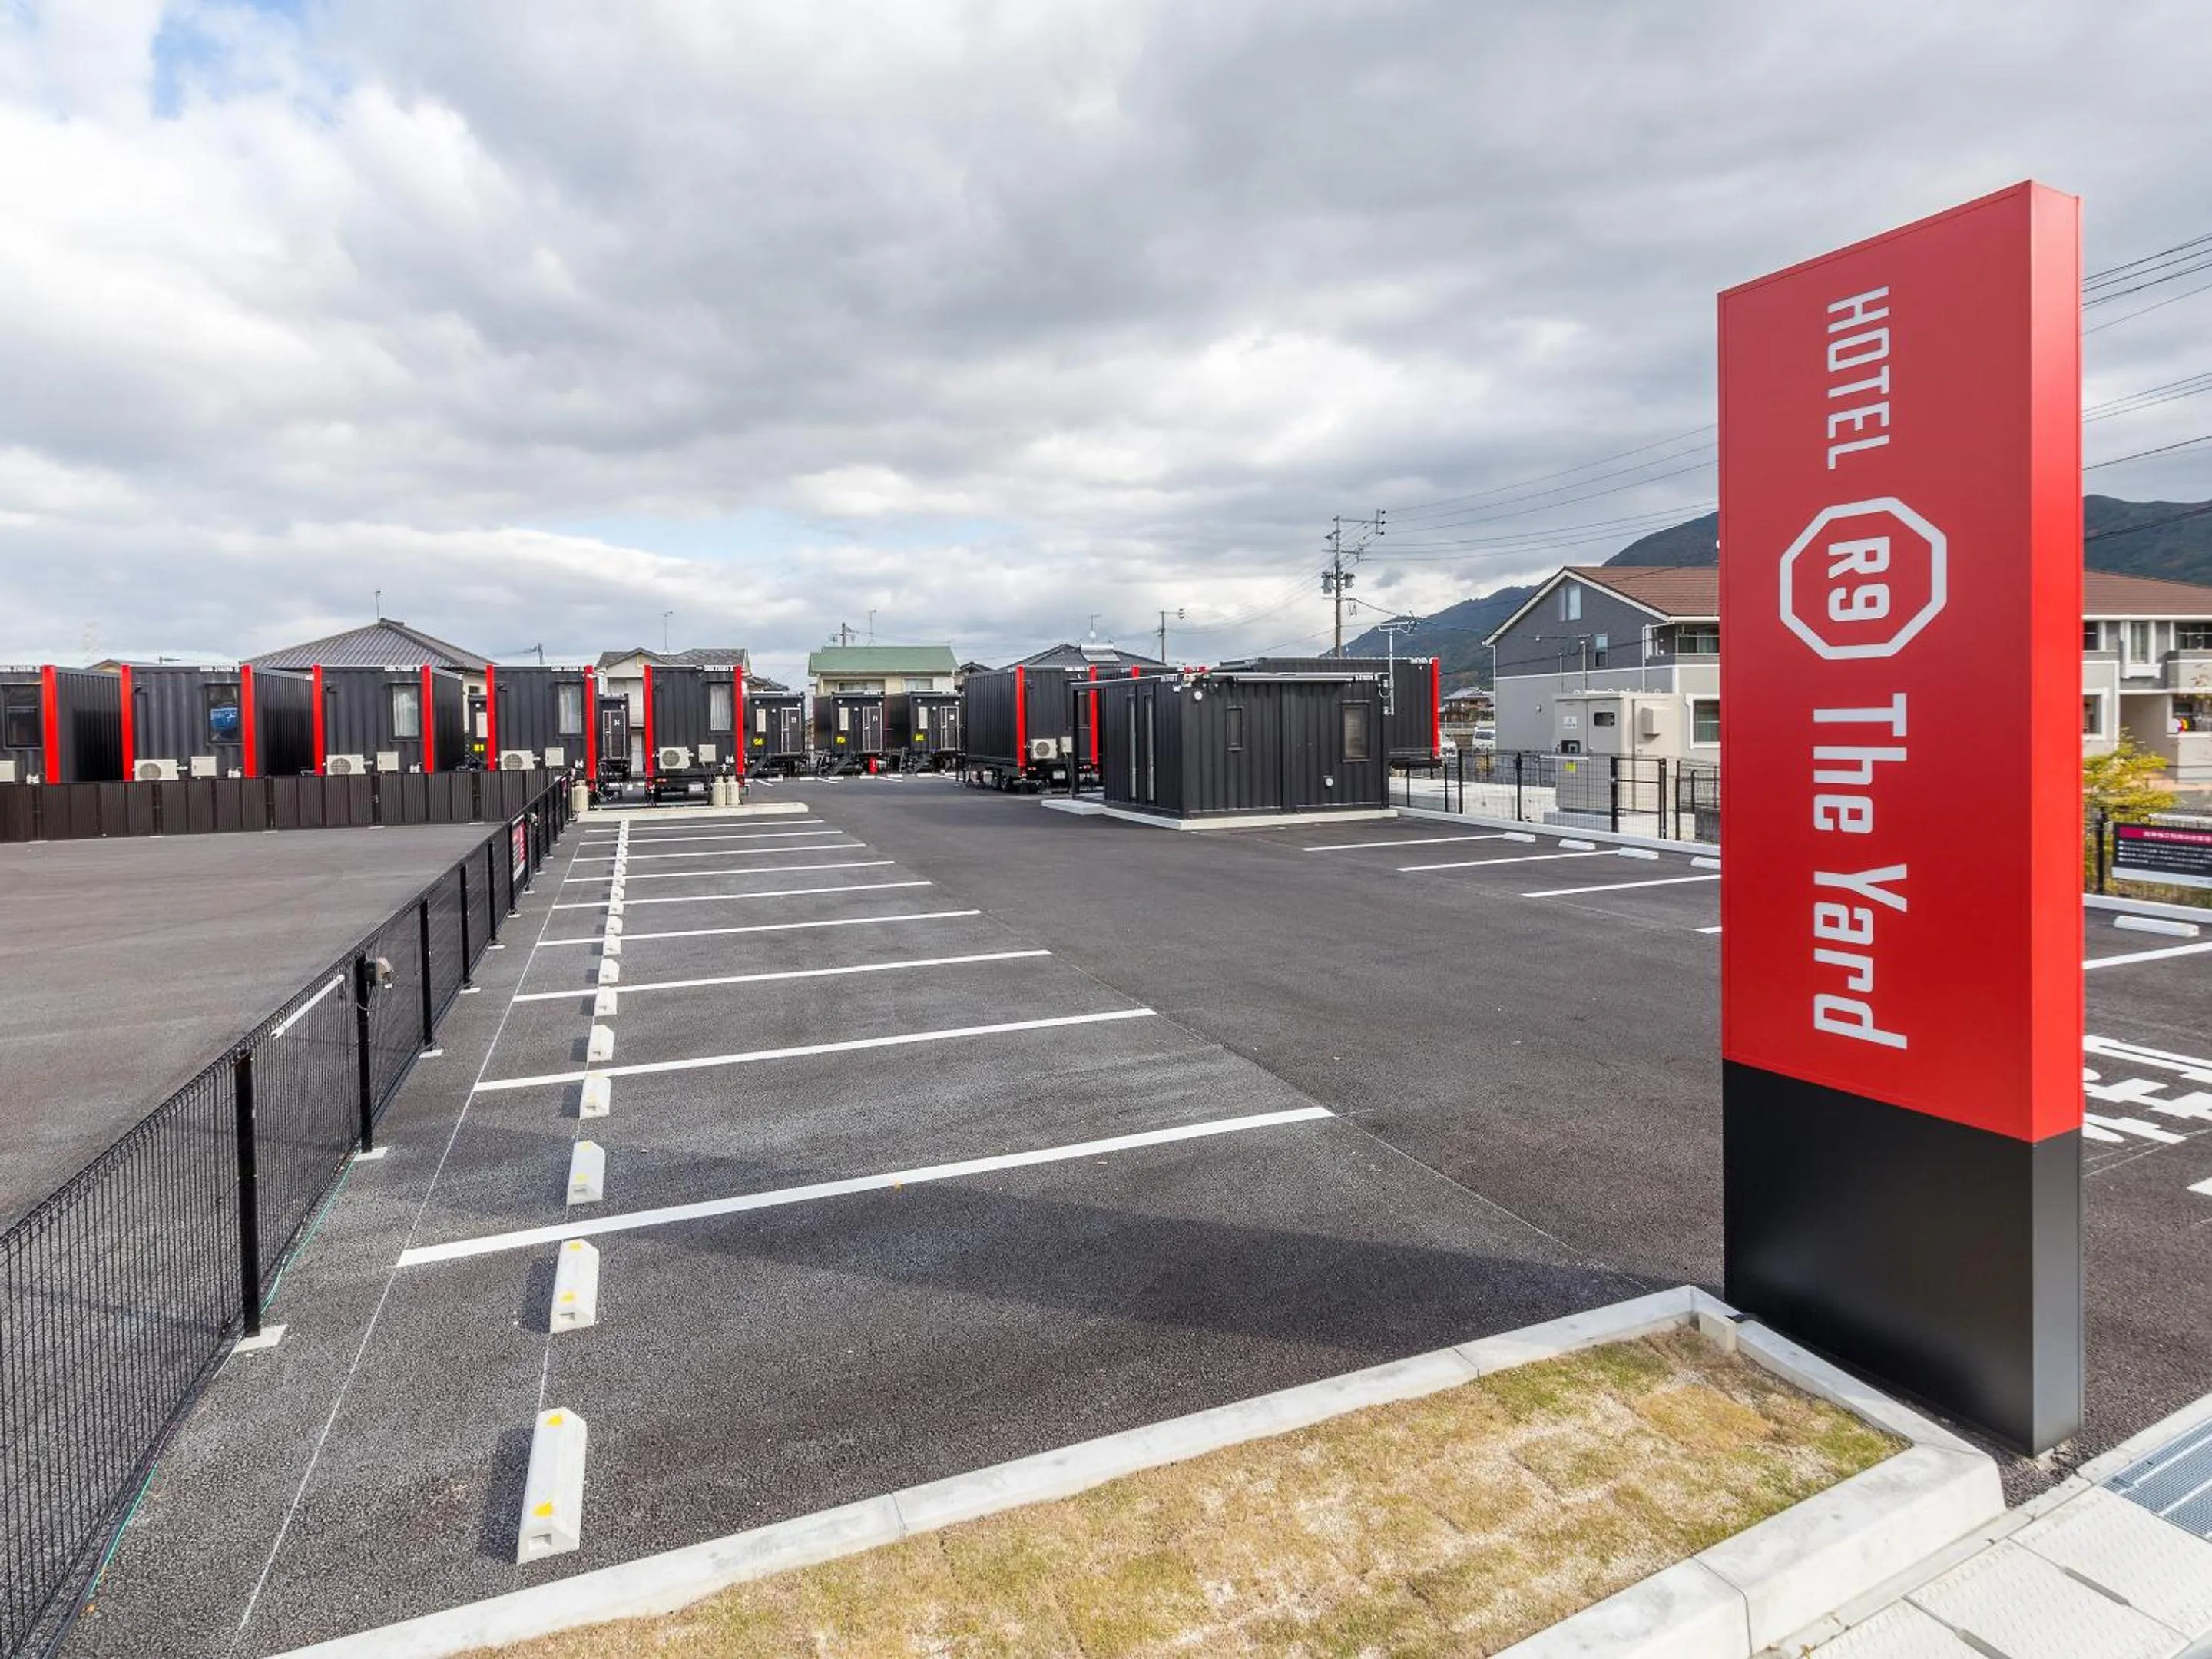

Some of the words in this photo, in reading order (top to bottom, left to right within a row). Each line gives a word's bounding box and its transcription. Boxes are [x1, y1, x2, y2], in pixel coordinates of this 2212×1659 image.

[1828, 286, 1889, 470] HOTEL
[1828, 536, 1889, 621] R9
[1813, 693, 1907, 834] The
[1813, 863, 1908, 1050] Yard
